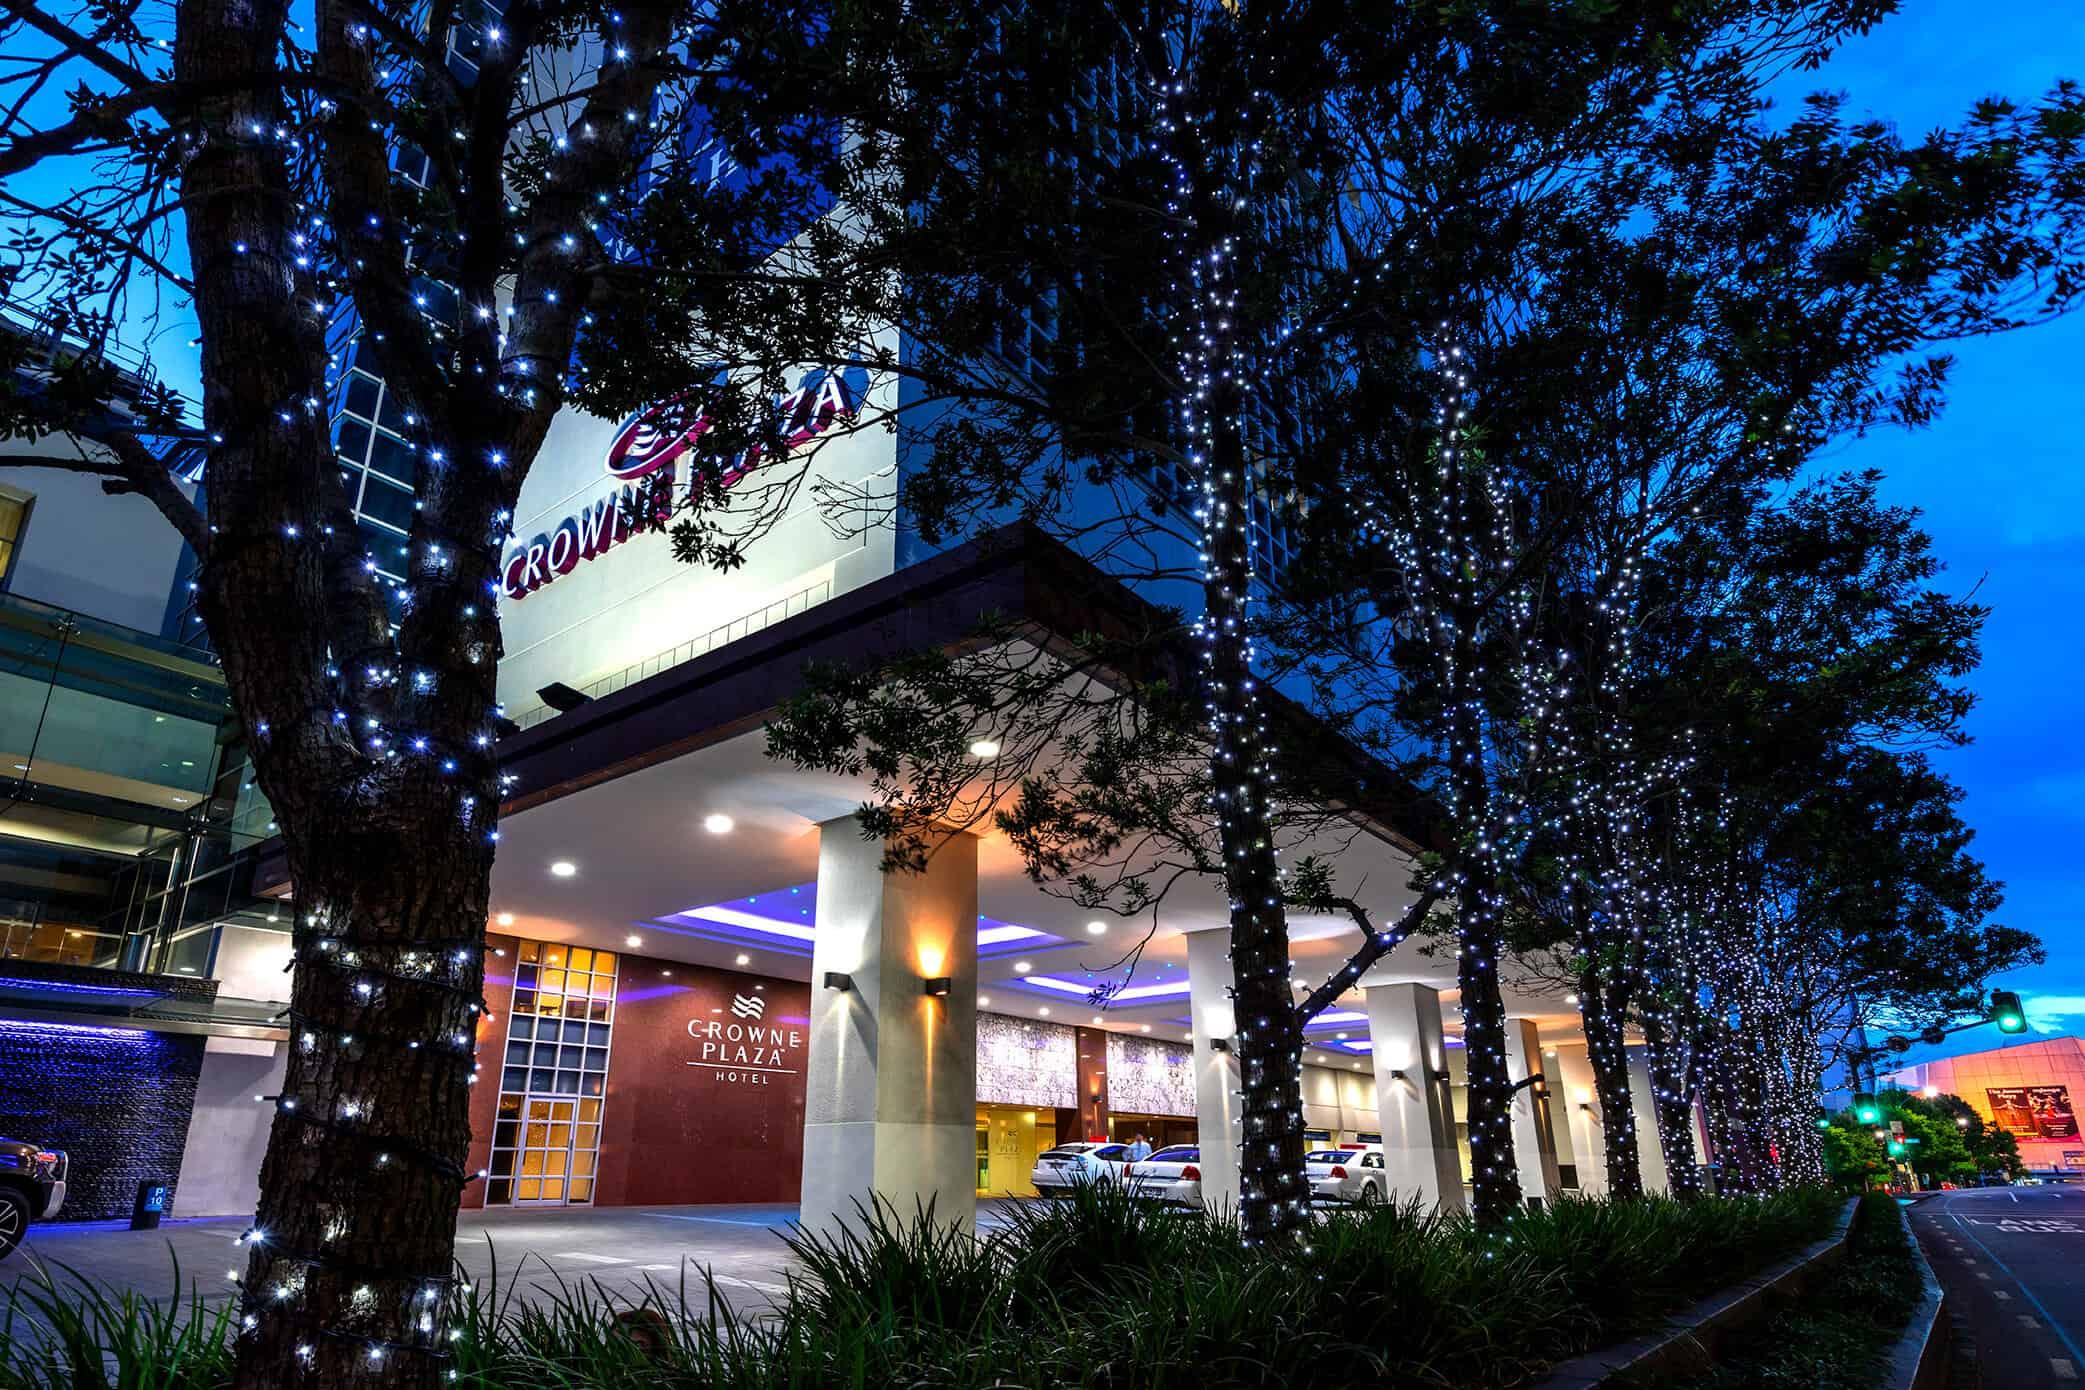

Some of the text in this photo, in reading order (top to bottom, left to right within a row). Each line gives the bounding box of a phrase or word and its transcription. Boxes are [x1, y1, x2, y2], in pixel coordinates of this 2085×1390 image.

[502, 466, 672, 598] CROWN
[687, 1018, 800, 1049] CROWNE
[701, 1041, 783, 1067] PLAZA
[715, 1071, 769, 1085] HOTEL
[151, 1196, 162, 1205] 10
[155, 1187, 164, 1197] P
